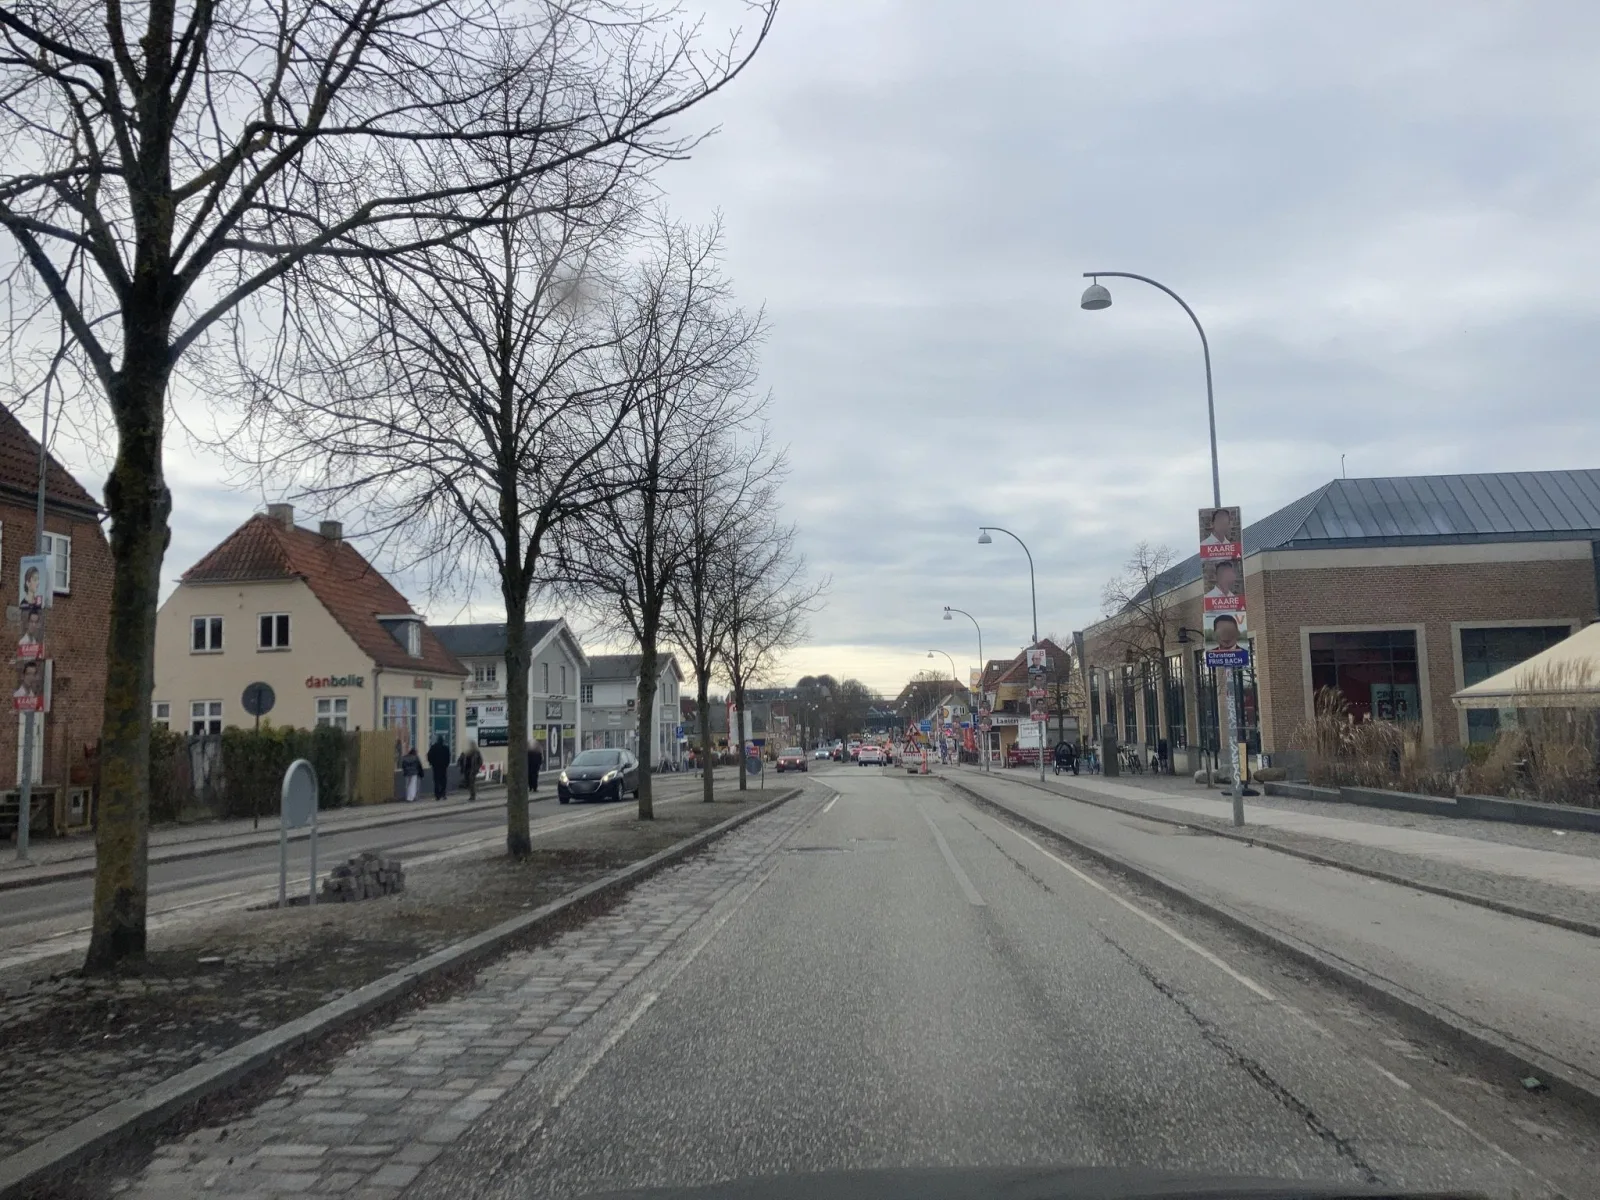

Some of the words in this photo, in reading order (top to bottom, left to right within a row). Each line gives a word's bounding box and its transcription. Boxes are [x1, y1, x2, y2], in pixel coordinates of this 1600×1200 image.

[1207, 544, 1235, 553] KAARE
[1211, 597, 1239, 605] KAARE
[1235, 614, 1244, 625] V
[305, 674, 365, 688] danbolig
